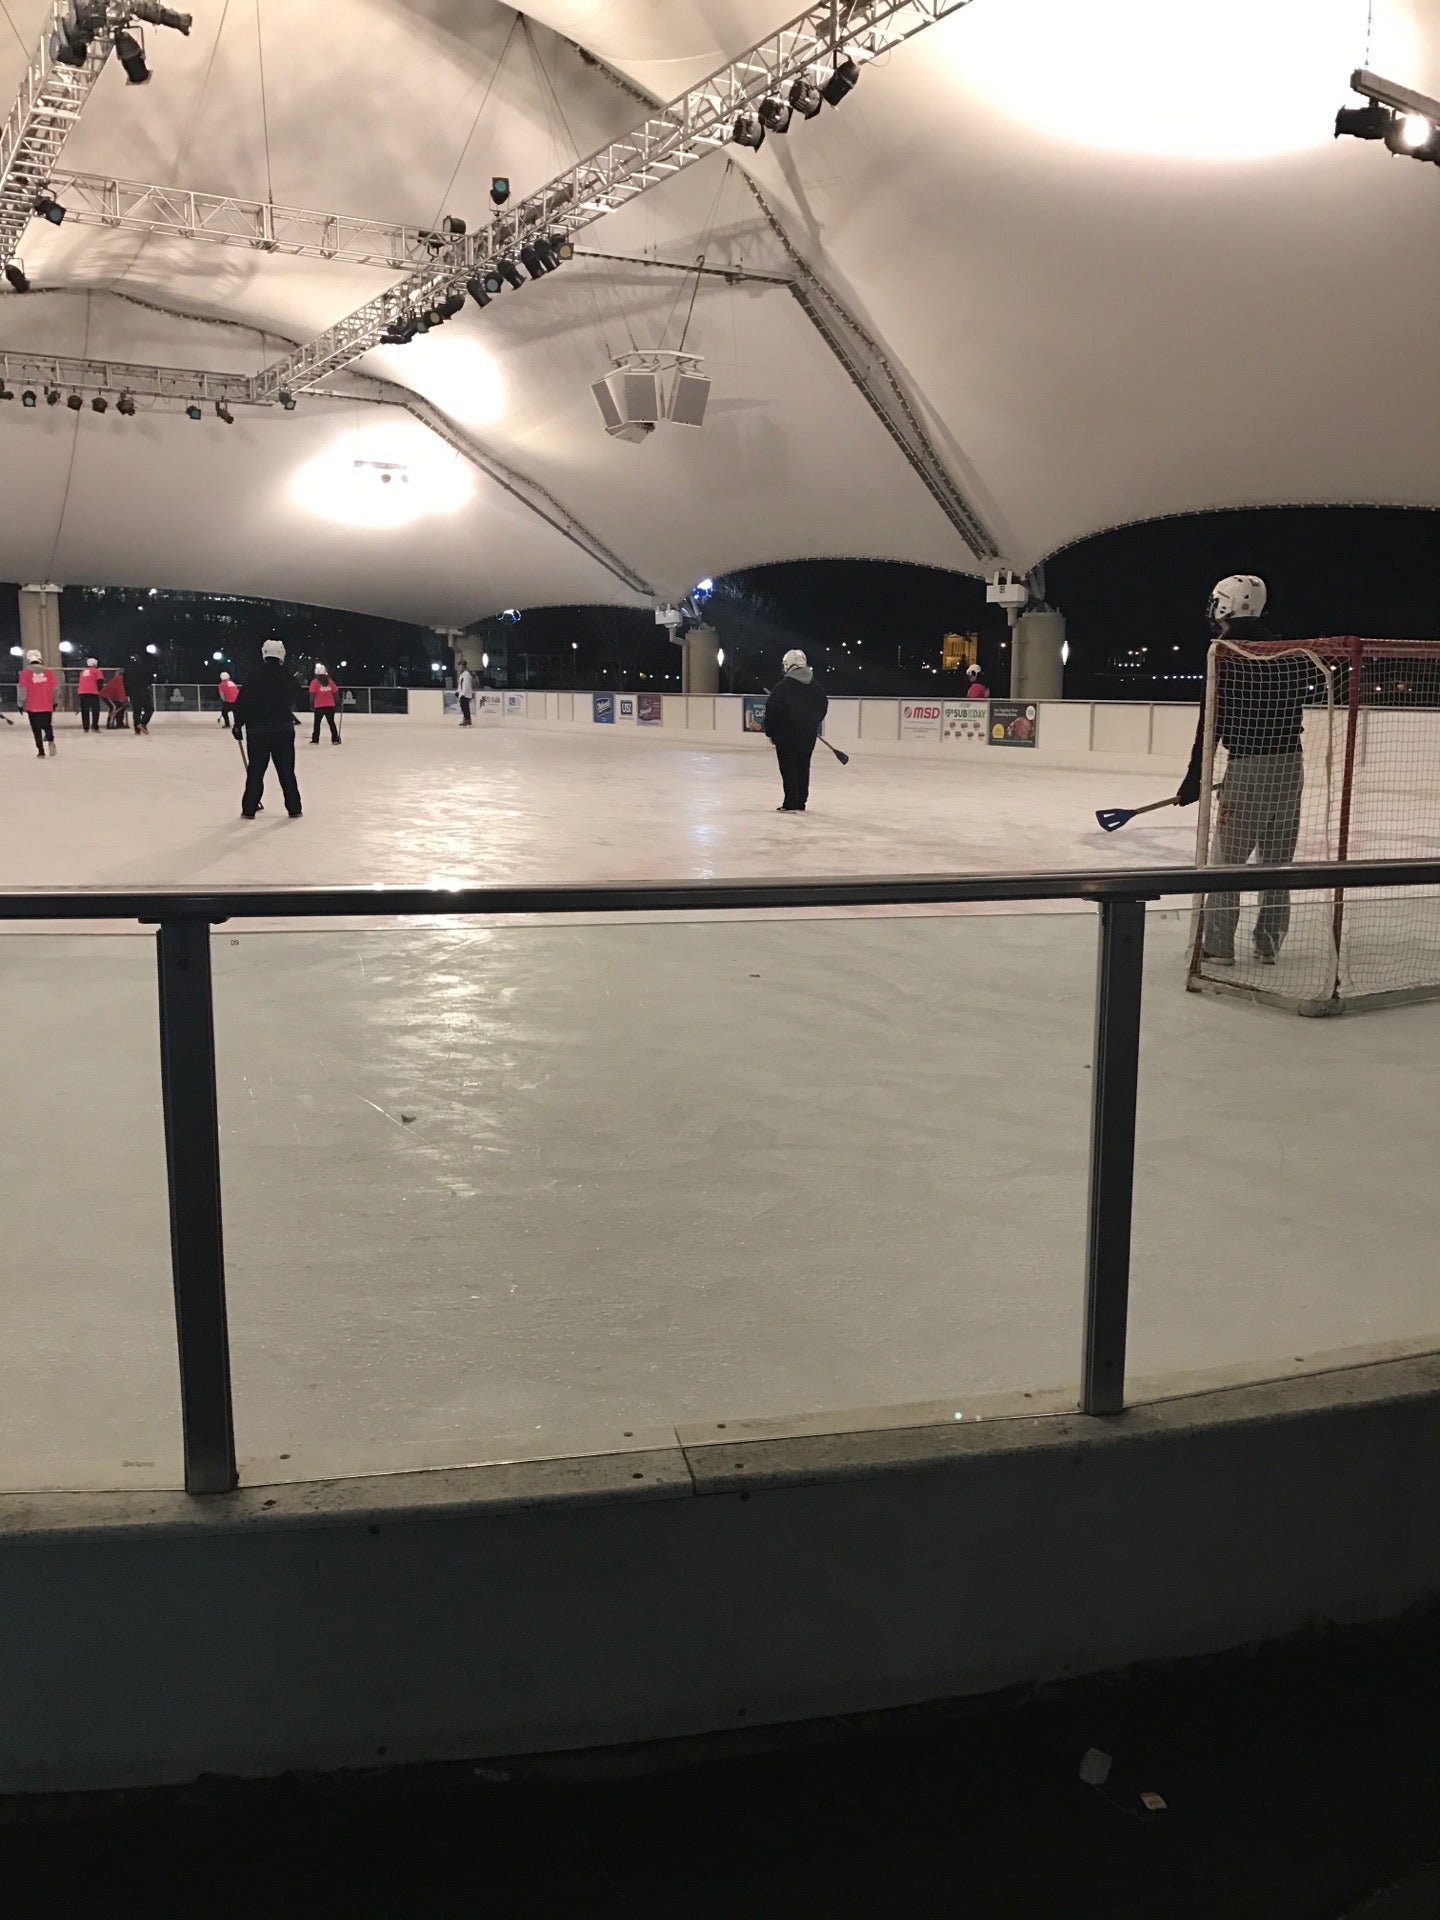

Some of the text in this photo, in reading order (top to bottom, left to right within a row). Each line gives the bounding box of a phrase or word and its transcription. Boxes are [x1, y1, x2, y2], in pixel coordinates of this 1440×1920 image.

[913, 706, 940, 719] MSD
[954, 709, 968, 718] SUB
[973, 709, 986, 719] DAY
